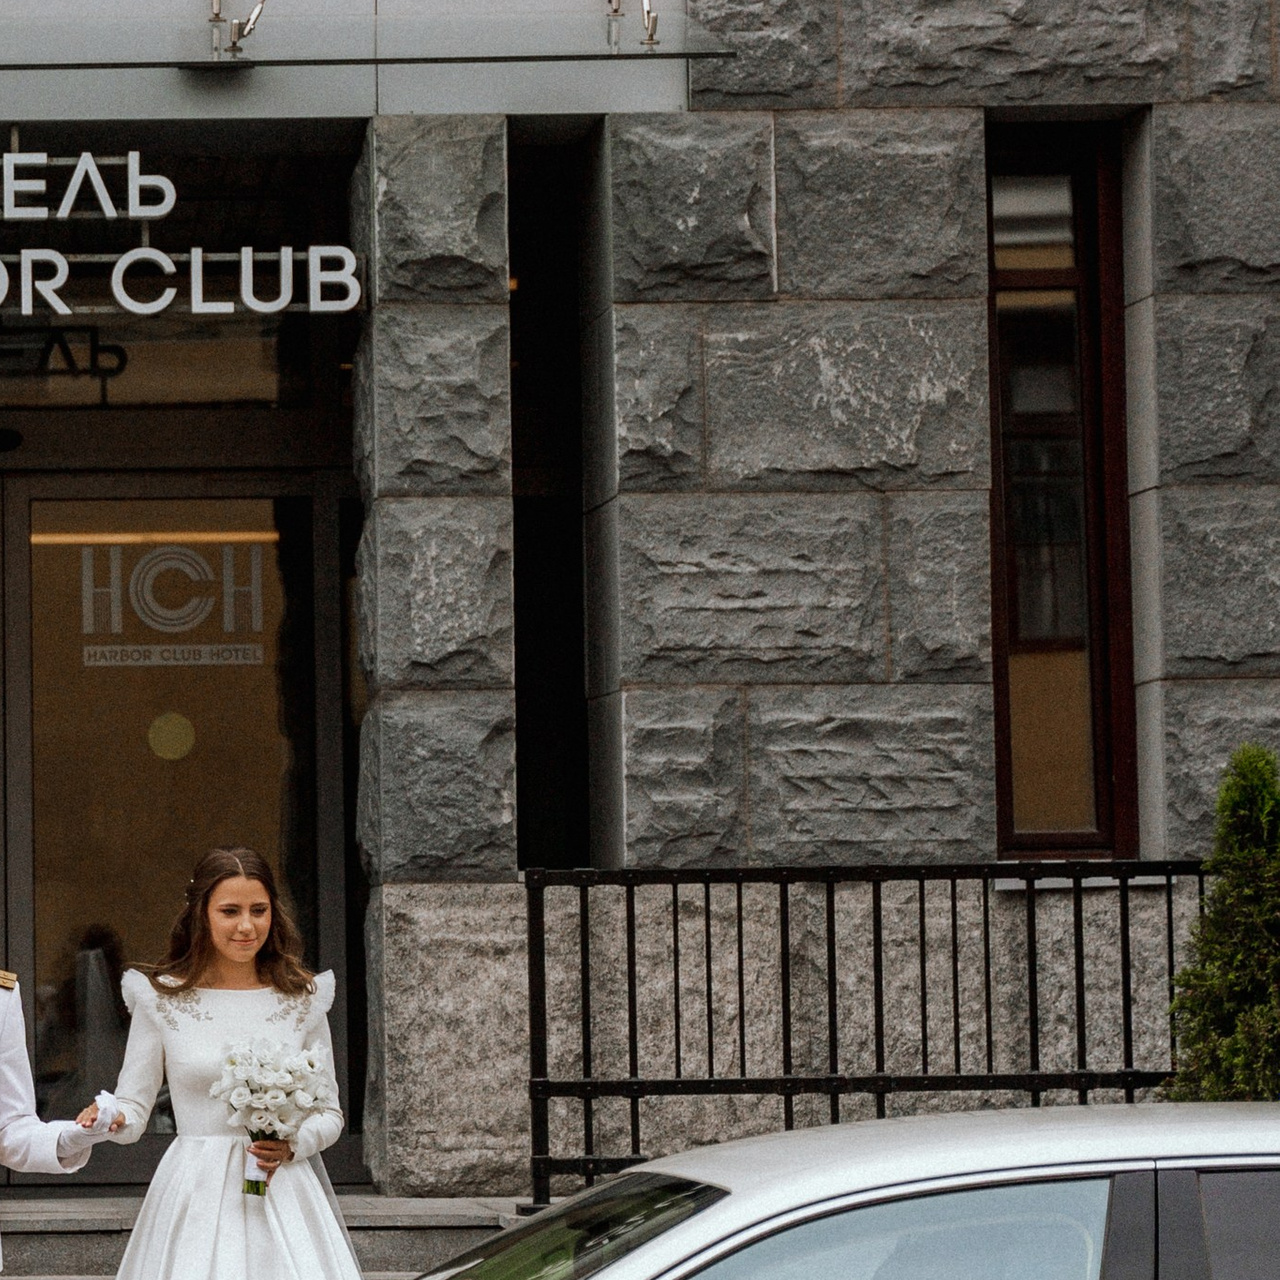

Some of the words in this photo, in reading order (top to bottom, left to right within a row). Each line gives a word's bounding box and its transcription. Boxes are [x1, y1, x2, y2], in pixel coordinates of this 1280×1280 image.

[111, 245, 362, 315] CLUB
[81, 544, 264, 635] HCH
[85, 648, 153, 663] HARBOR
[159, 647, 203, 662] CLUB
[208, 646, 261, 661] HOTEL
